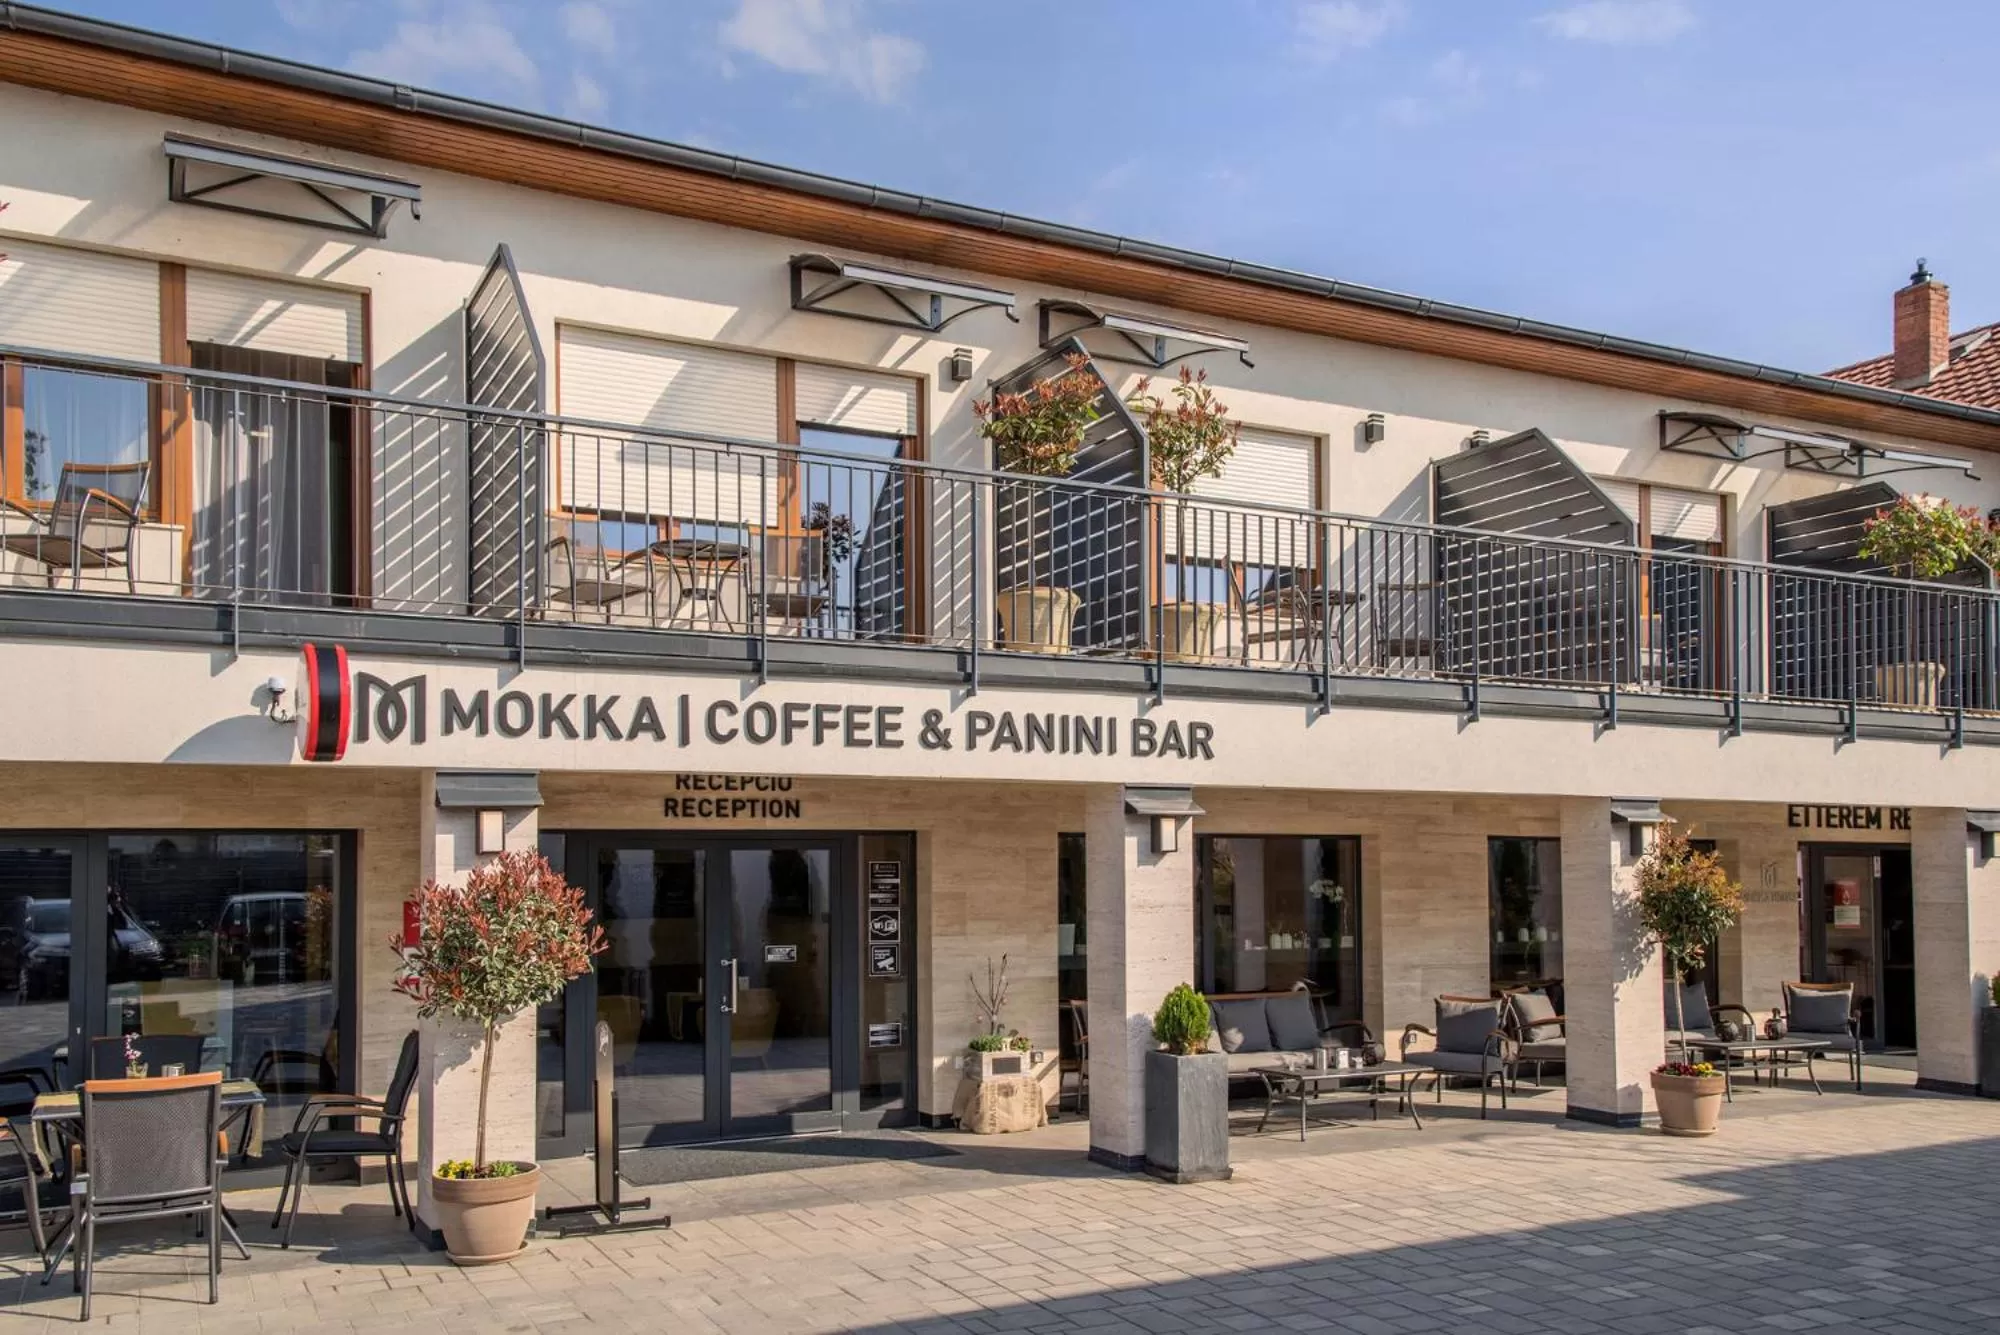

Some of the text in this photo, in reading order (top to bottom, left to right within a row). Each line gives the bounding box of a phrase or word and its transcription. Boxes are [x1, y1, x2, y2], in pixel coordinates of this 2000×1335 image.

[441, 688, 667, 741] MOKKA
[705, 700, 904, 749] COFFEE
[918, 708, 953, 751] &
[966, 710, 1117, 756] PANINI
[1130, 718, 1215, 760] BAR
[664, 797, 801, 818] RECEPTION
